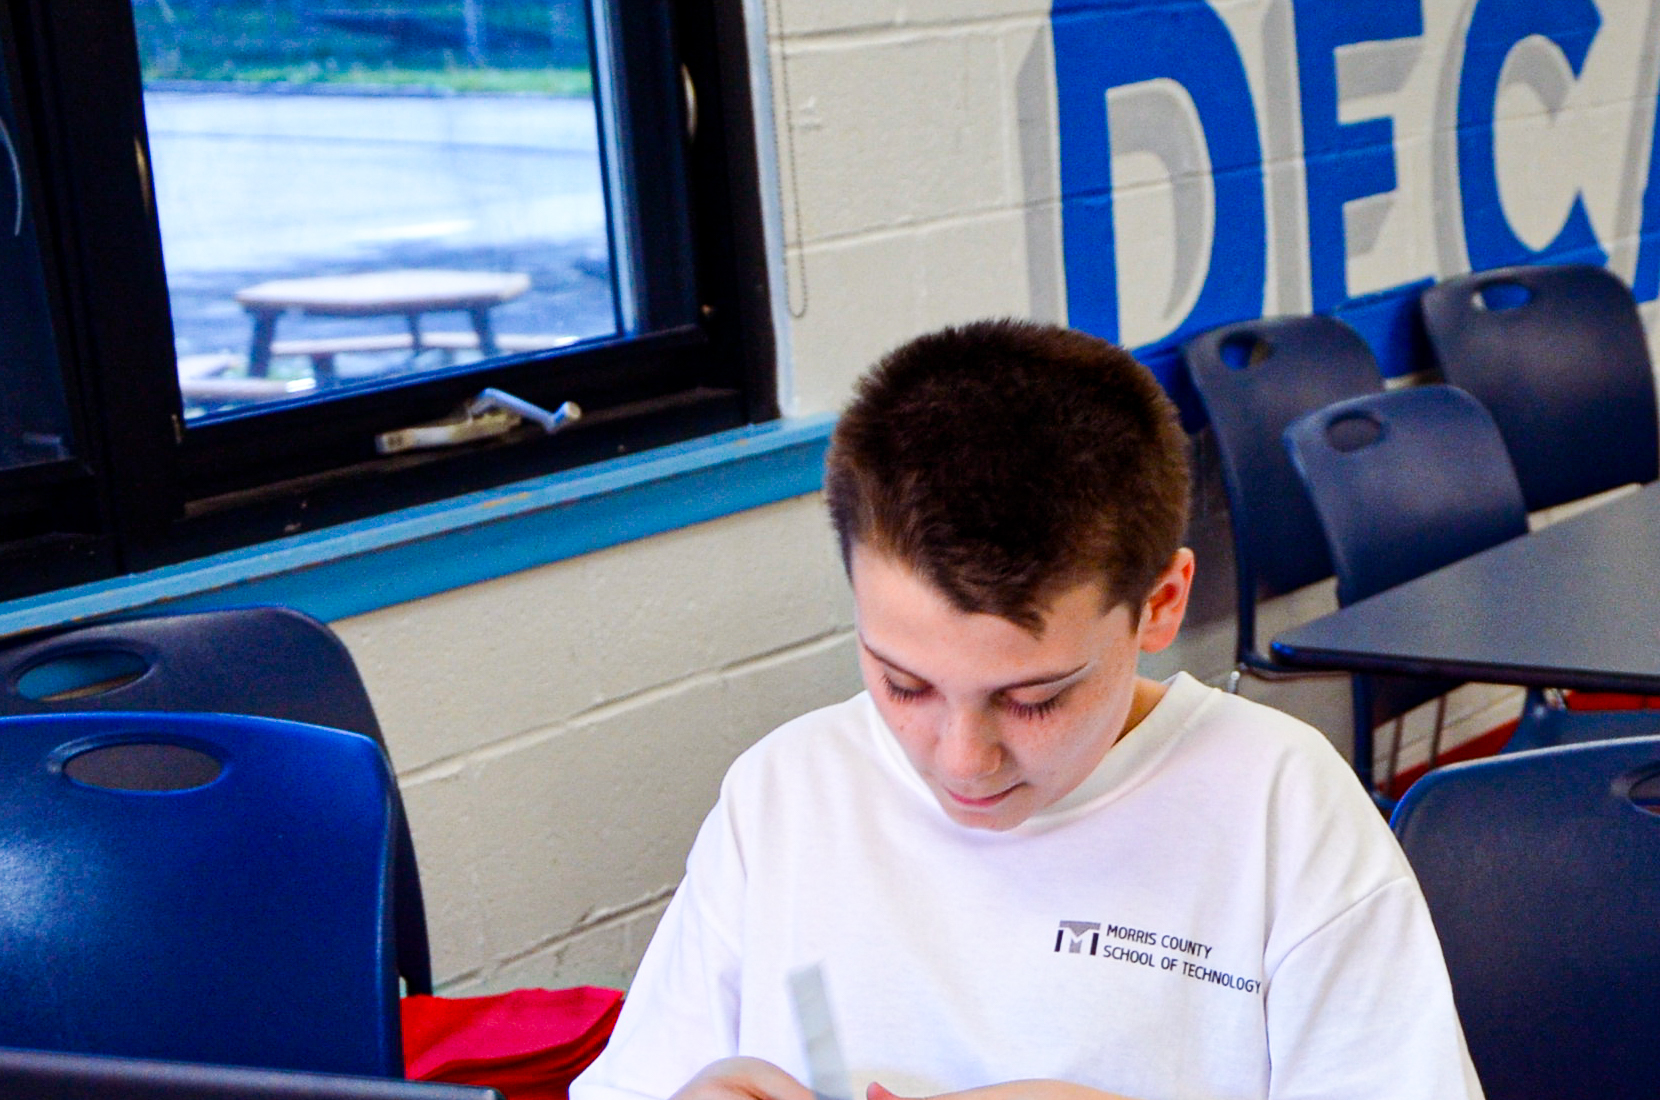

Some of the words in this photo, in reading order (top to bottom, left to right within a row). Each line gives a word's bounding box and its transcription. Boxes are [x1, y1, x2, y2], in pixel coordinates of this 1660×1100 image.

[1106, 924, 1157, 946] MORRIS
[1161, 934, 1212, 959] COUNTY
[1102, 945, 1155, 968] SCHOOL
[1160, 956, 1178, 971] OF
[1182, 961, 1262, 994] TECHNOLOGY
